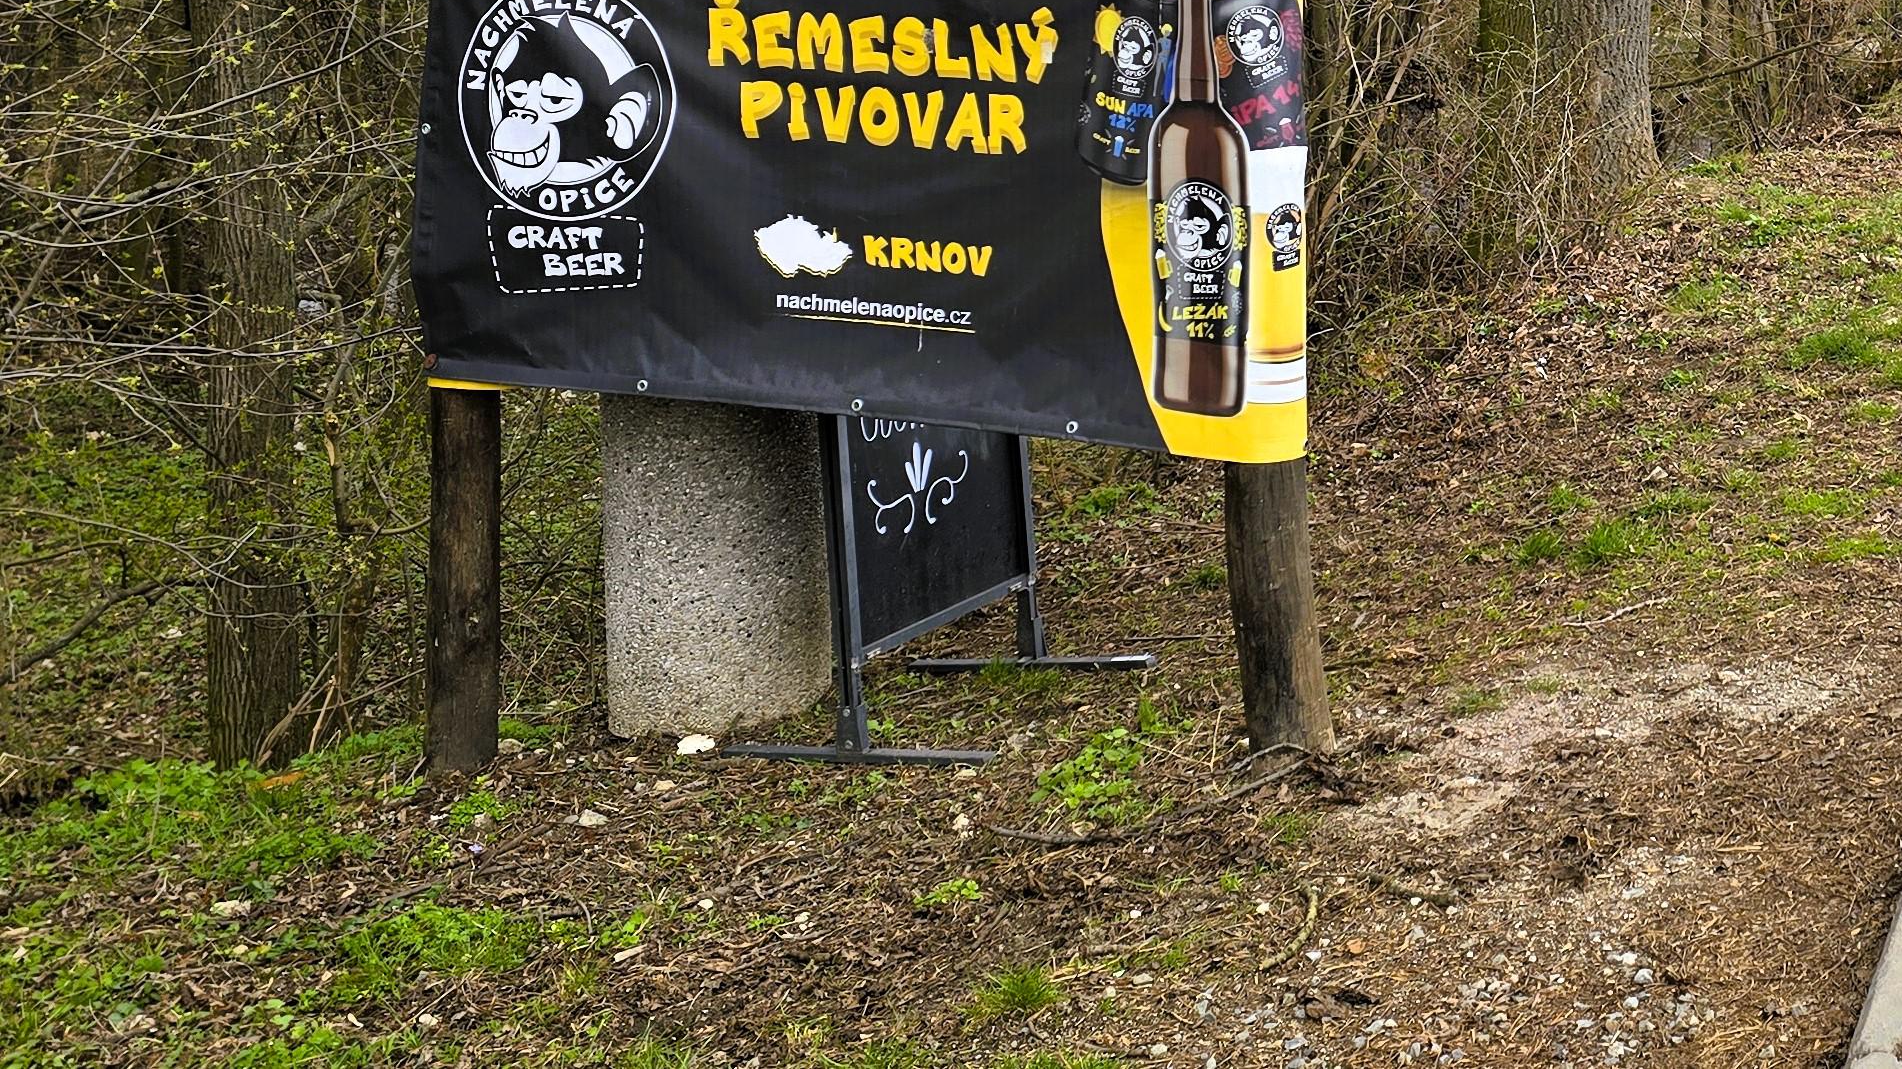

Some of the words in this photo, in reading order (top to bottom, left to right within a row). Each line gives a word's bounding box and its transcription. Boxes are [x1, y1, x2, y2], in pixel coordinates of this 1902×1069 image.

[740, 80, 1027, 155] PIVOVAR
[1095, 91, 1127, 115] SUN
[1127, 102, 1154, 119] APA
[507, 225, 603, 250] CRAFT
[542, 252, 625, 277] BEER
[862, 234, 993, 277] KRNOV
[1192, 283, 1219, 294] BEER
[776, 293, 972, 325] nachmelenaopice.cz
[1172, 301, 1229, 321] LEŽÁK
[1186, 321, 1215, 340] 11%
